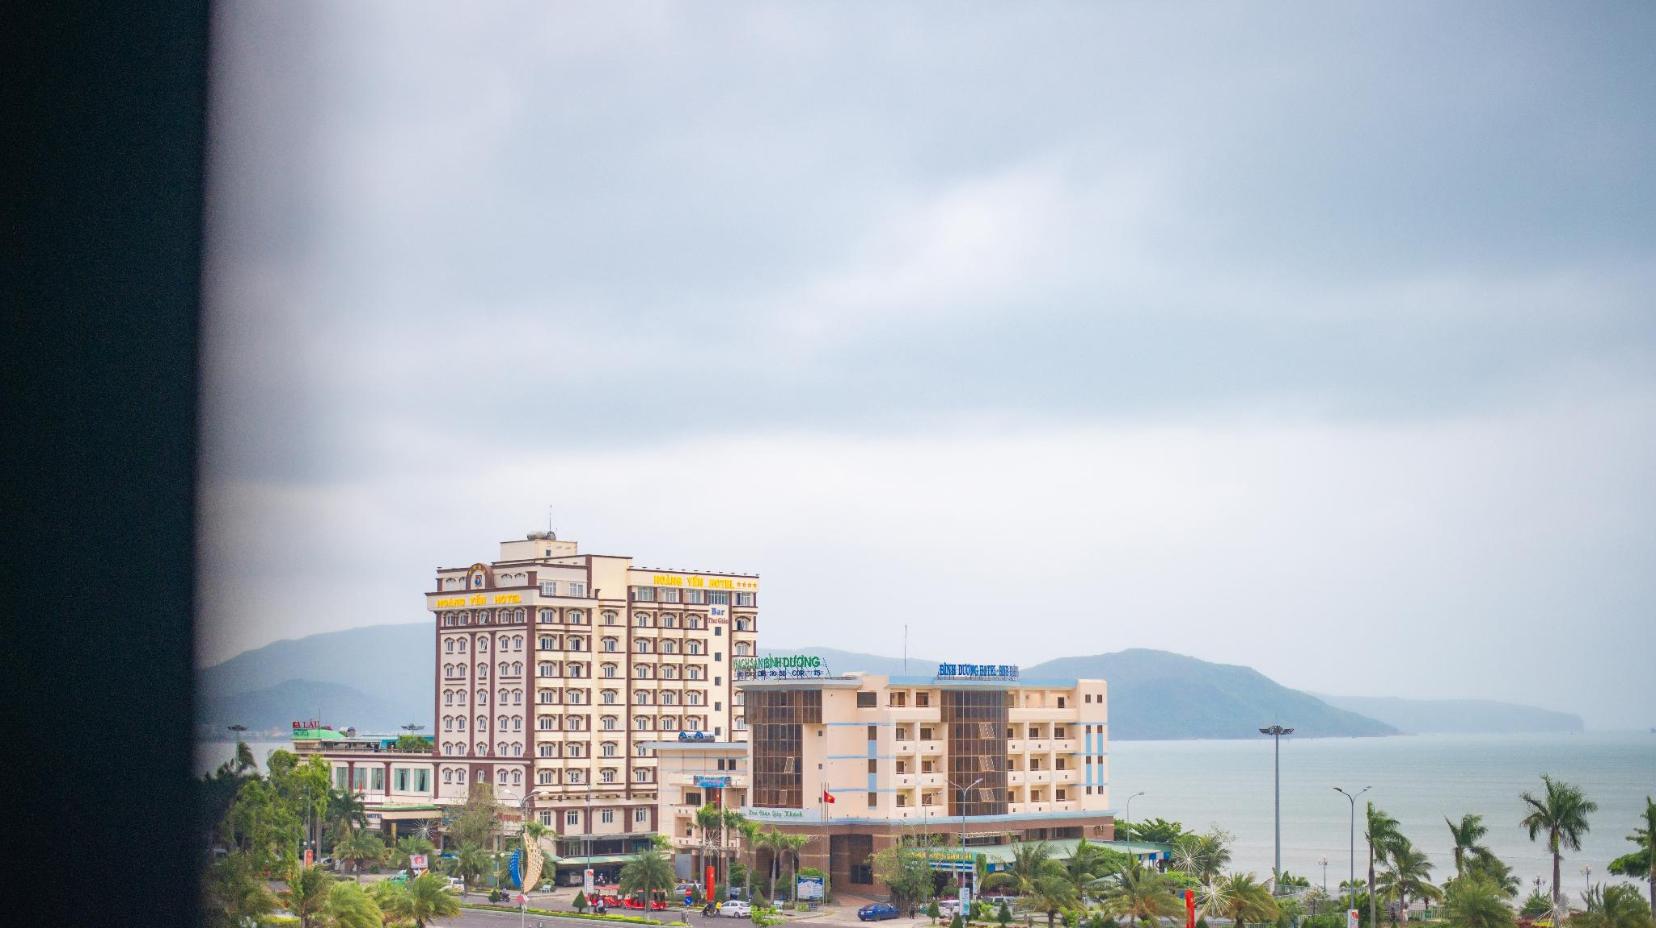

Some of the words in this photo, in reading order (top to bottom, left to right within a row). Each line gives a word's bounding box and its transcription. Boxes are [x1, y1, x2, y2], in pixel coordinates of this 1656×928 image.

[708, 578, 735, 589] HOTEL
[495, 594, 521, 605] HOTEL
[711, 607, 725, 616] Bar
